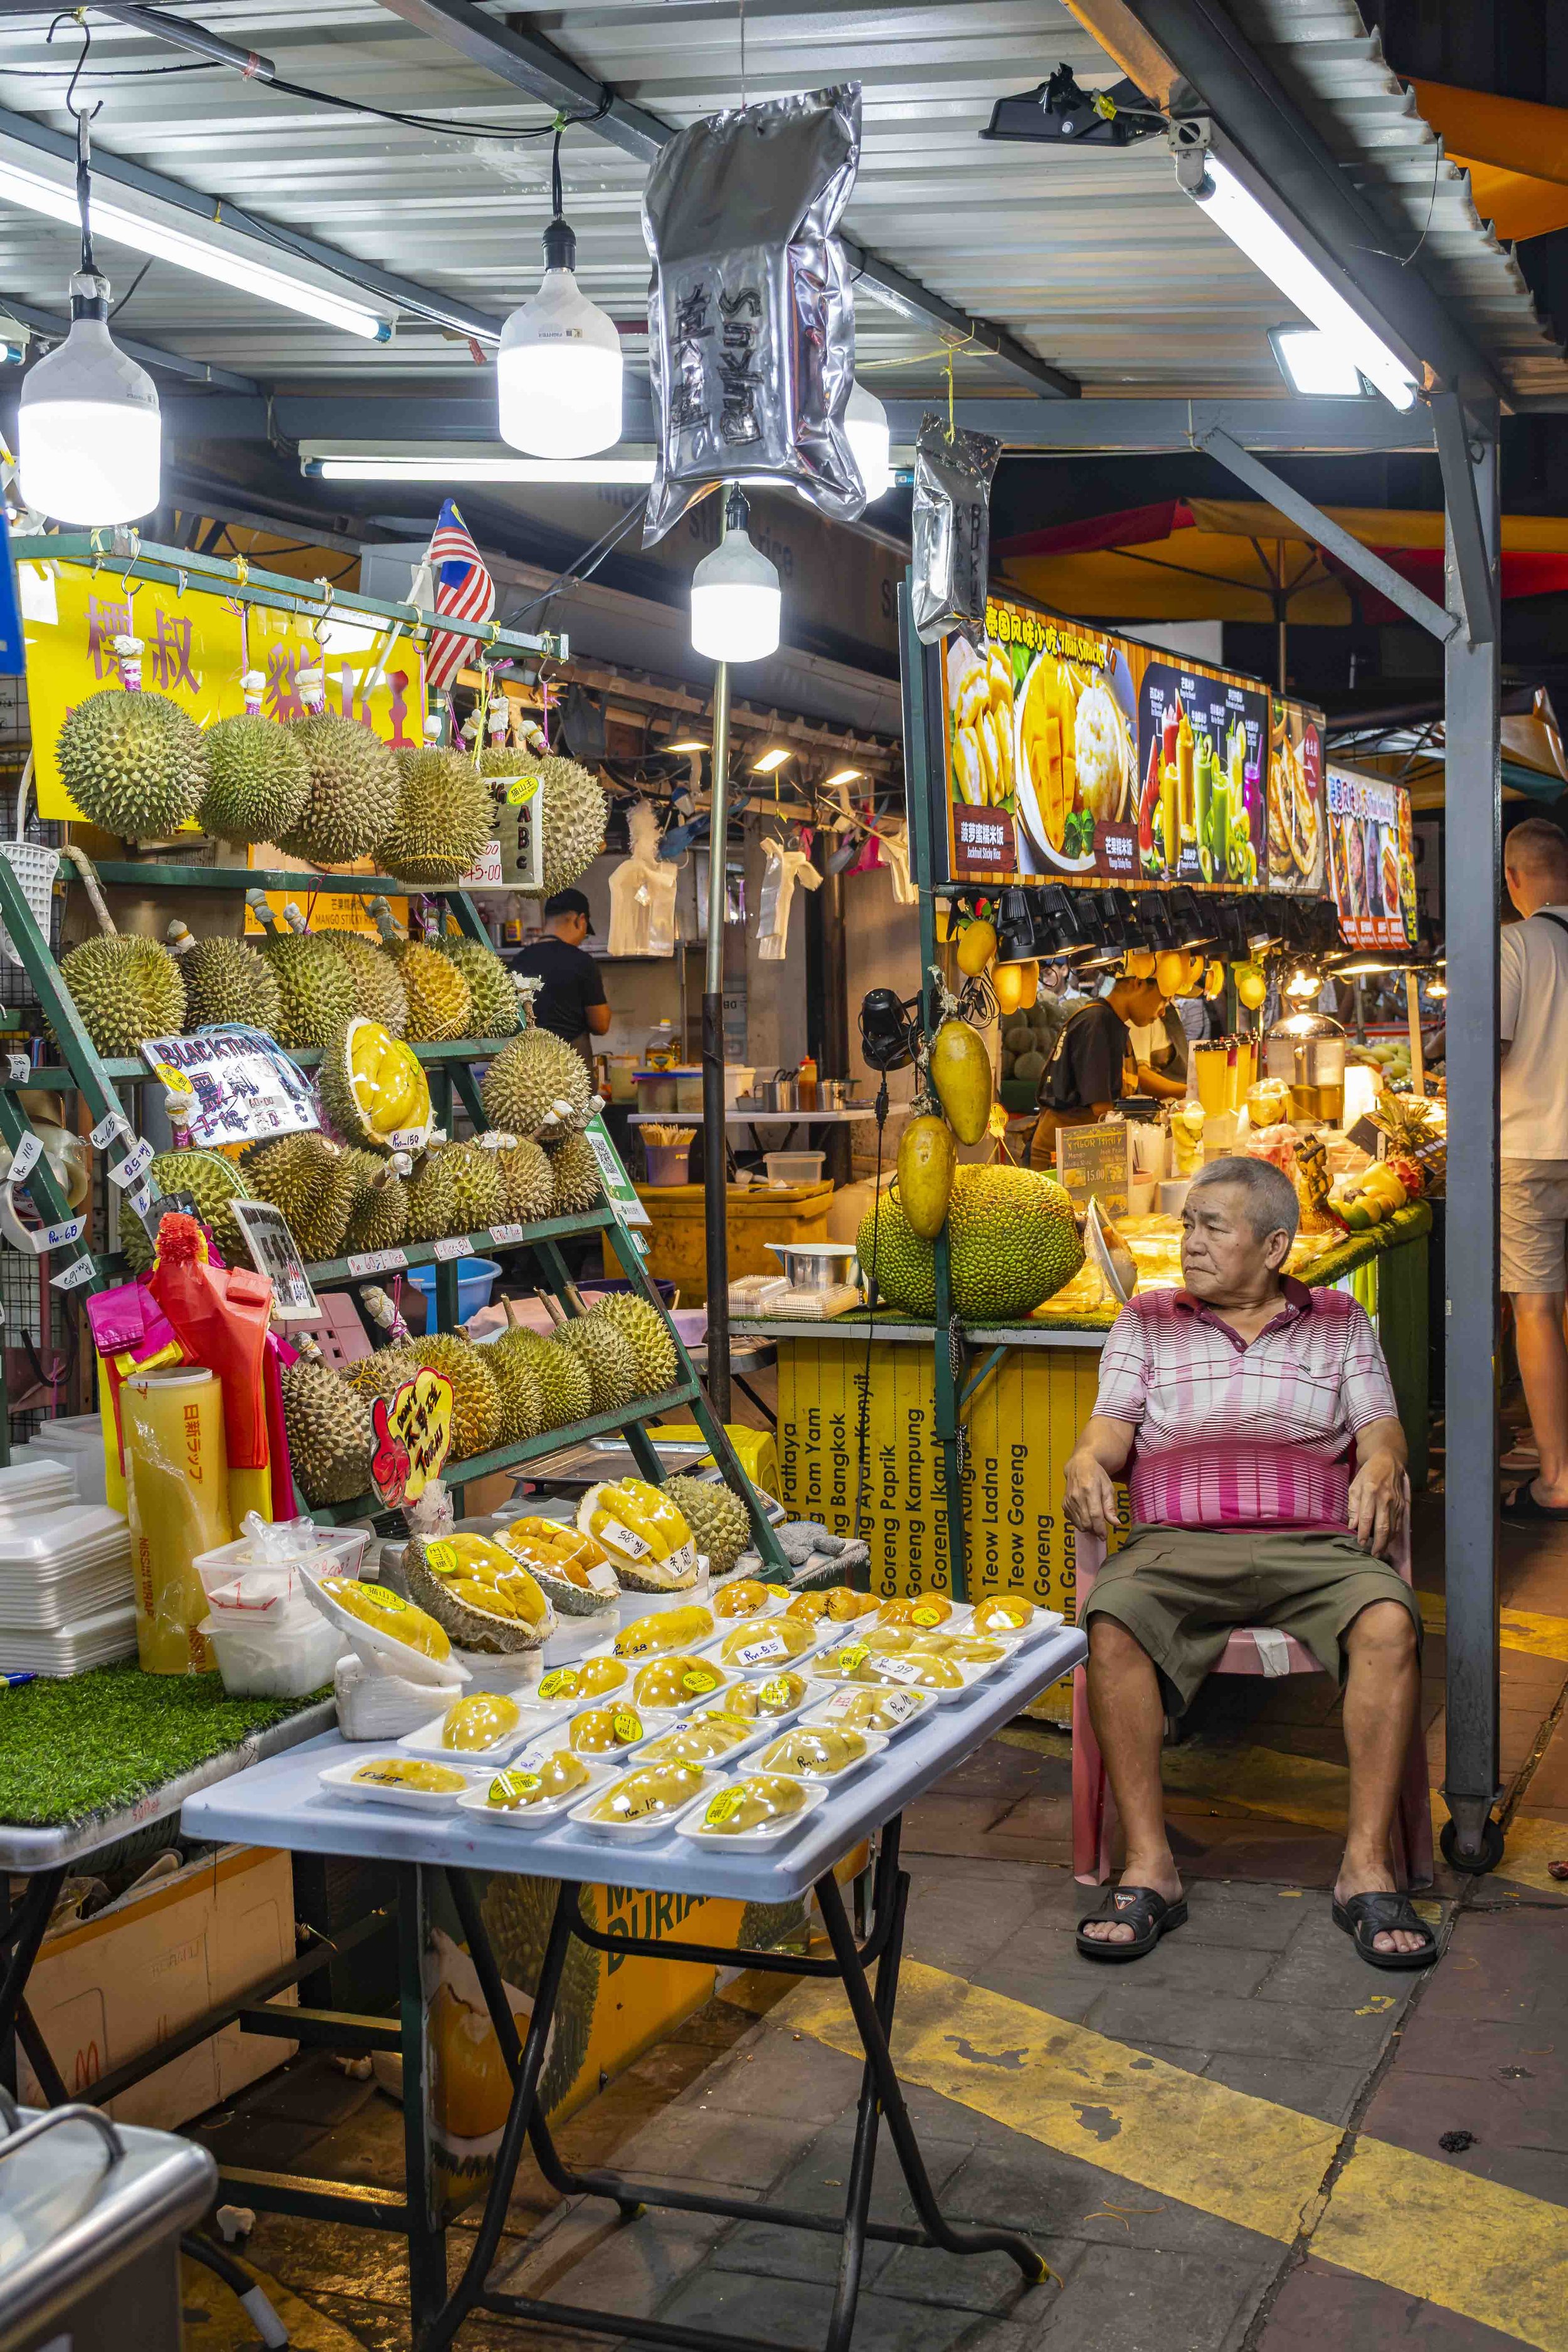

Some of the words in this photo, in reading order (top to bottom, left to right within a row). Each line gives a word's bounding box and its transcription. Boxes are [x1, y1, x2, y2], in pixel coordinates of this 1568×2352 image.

[511, 779, 534, 798] 猫山王
[315, 914, 339, 924] MANGO
[341, 914, 364, 925] STICKY
[1086, 1168, 1104, 1182] 15.00
[805, 1407, 821, 1454] Yam
[853, 1373, 874, 1438] Kunyit
[183, 1403, 204, 1485] 日新ラップ
[780, 1422, 801, 1503] Pattaya
[829, 1412, 850, 1507] Bangkok
[905, 1409, 925, 1512] Kampung
[805, 1462, 822, 1505] Tom
[855, 1446, 875, 1509] Ayam
[879, 1444, 900, 1510] Paprik
[930, 1455, 947, 1502] Ikan
[981, 1457, 999, 1524] Ladna
[1007, 1444, 1029, 1526] Goreng
[1113, 1488, 1130, 1535] Tom
[139, 1537, 152, 1580] NISSIN
[880, 1517, 901, 1597] Goreng
[905, 1519, 926, 1598] Goreng
[931, 1508, 949, 1590] Goreng
[982, 1530, 999, 1586] Teow
[1007, 1533, 1025, 1588] Teow
[1034, 1514, 1055, 1596] Goreng
[1059, 1519, 1076, 1589] Goren
[367, 1586, 400, 1603] 猫山王
